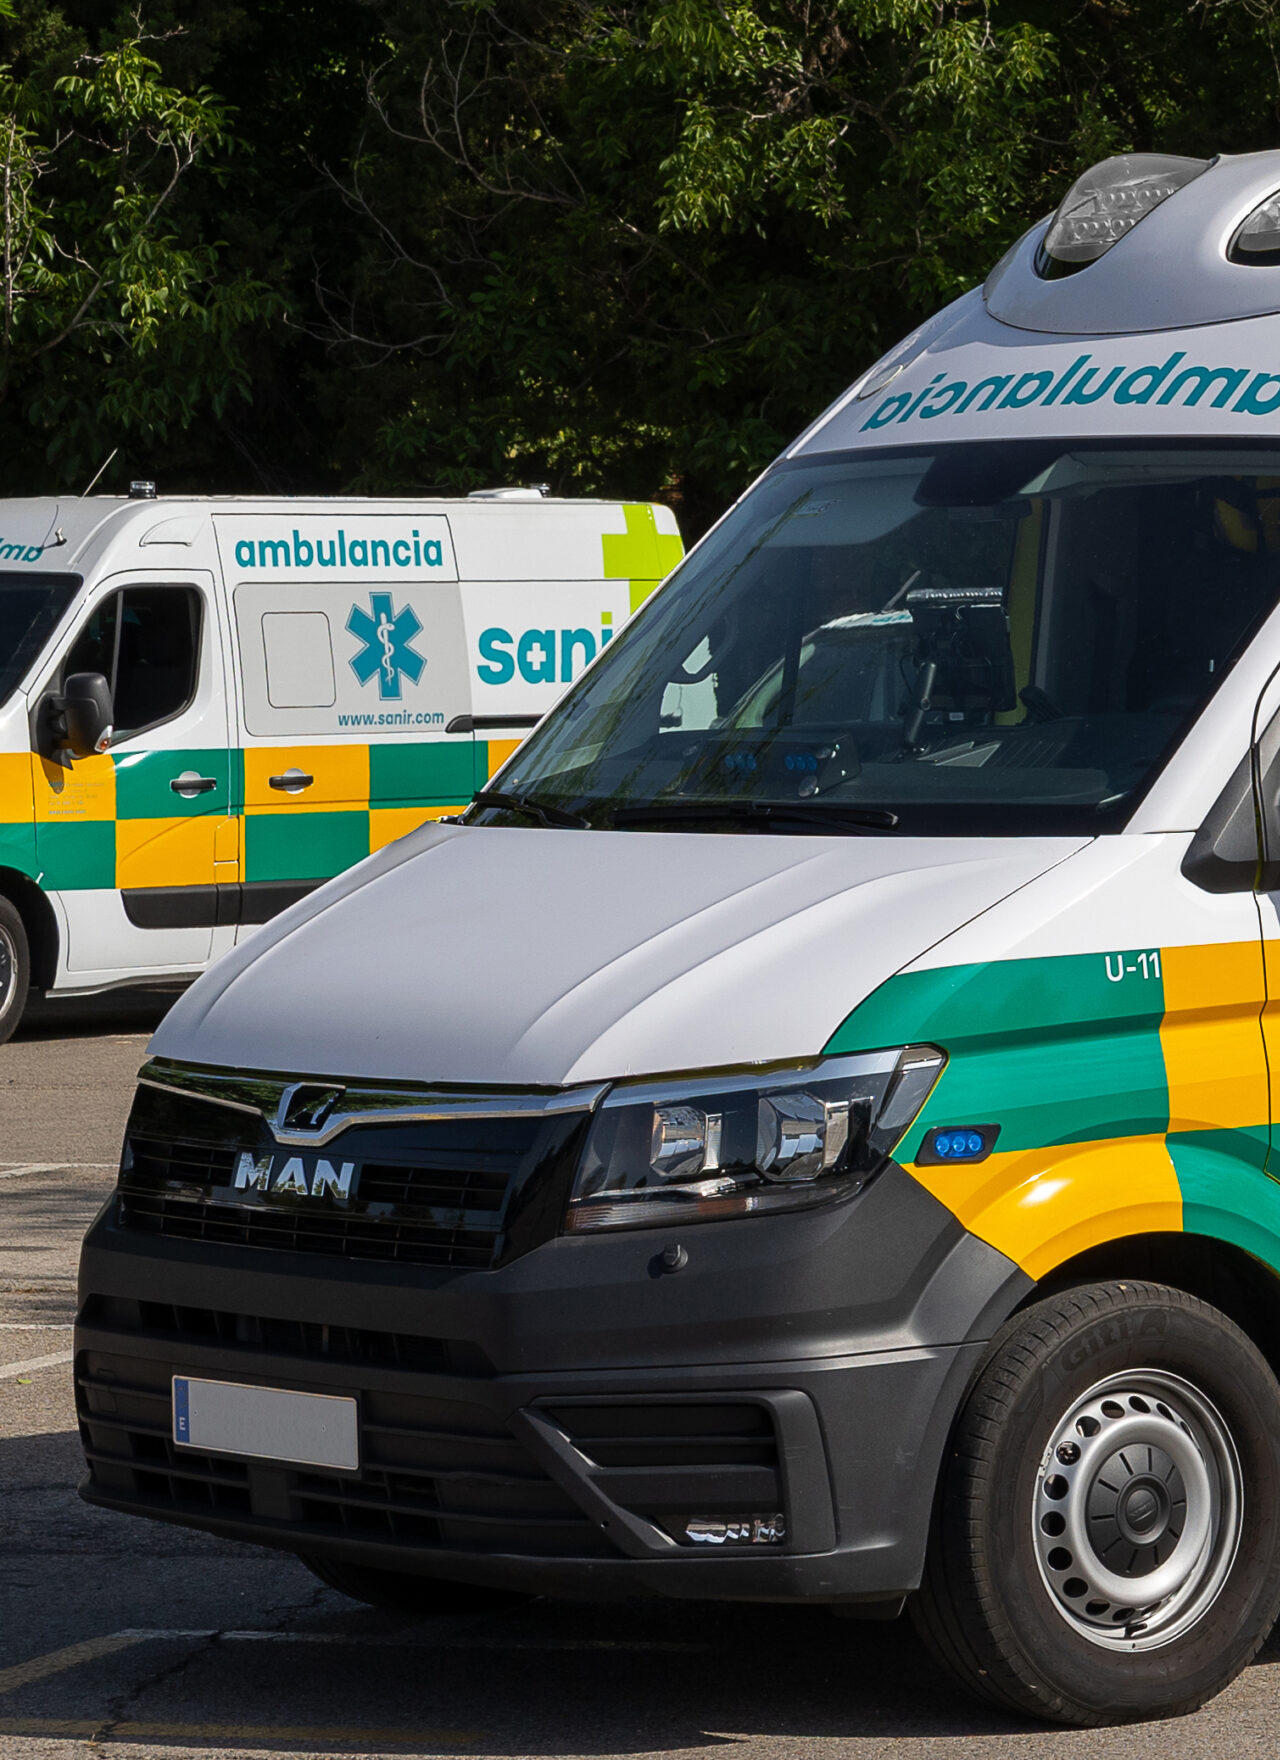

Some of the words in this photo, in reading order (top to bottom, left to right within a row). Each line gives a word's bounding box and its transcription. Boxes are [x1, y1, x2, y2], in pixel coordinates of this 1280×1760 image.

[235, 530, 442, 567] ambulancia
[338, 709, 444, 726] www.sanir.com
[1104, 951, 1160, 982] U-11
[234, 1152, 355, 1199] MAN
[179, 1416, 186, 1431] E
